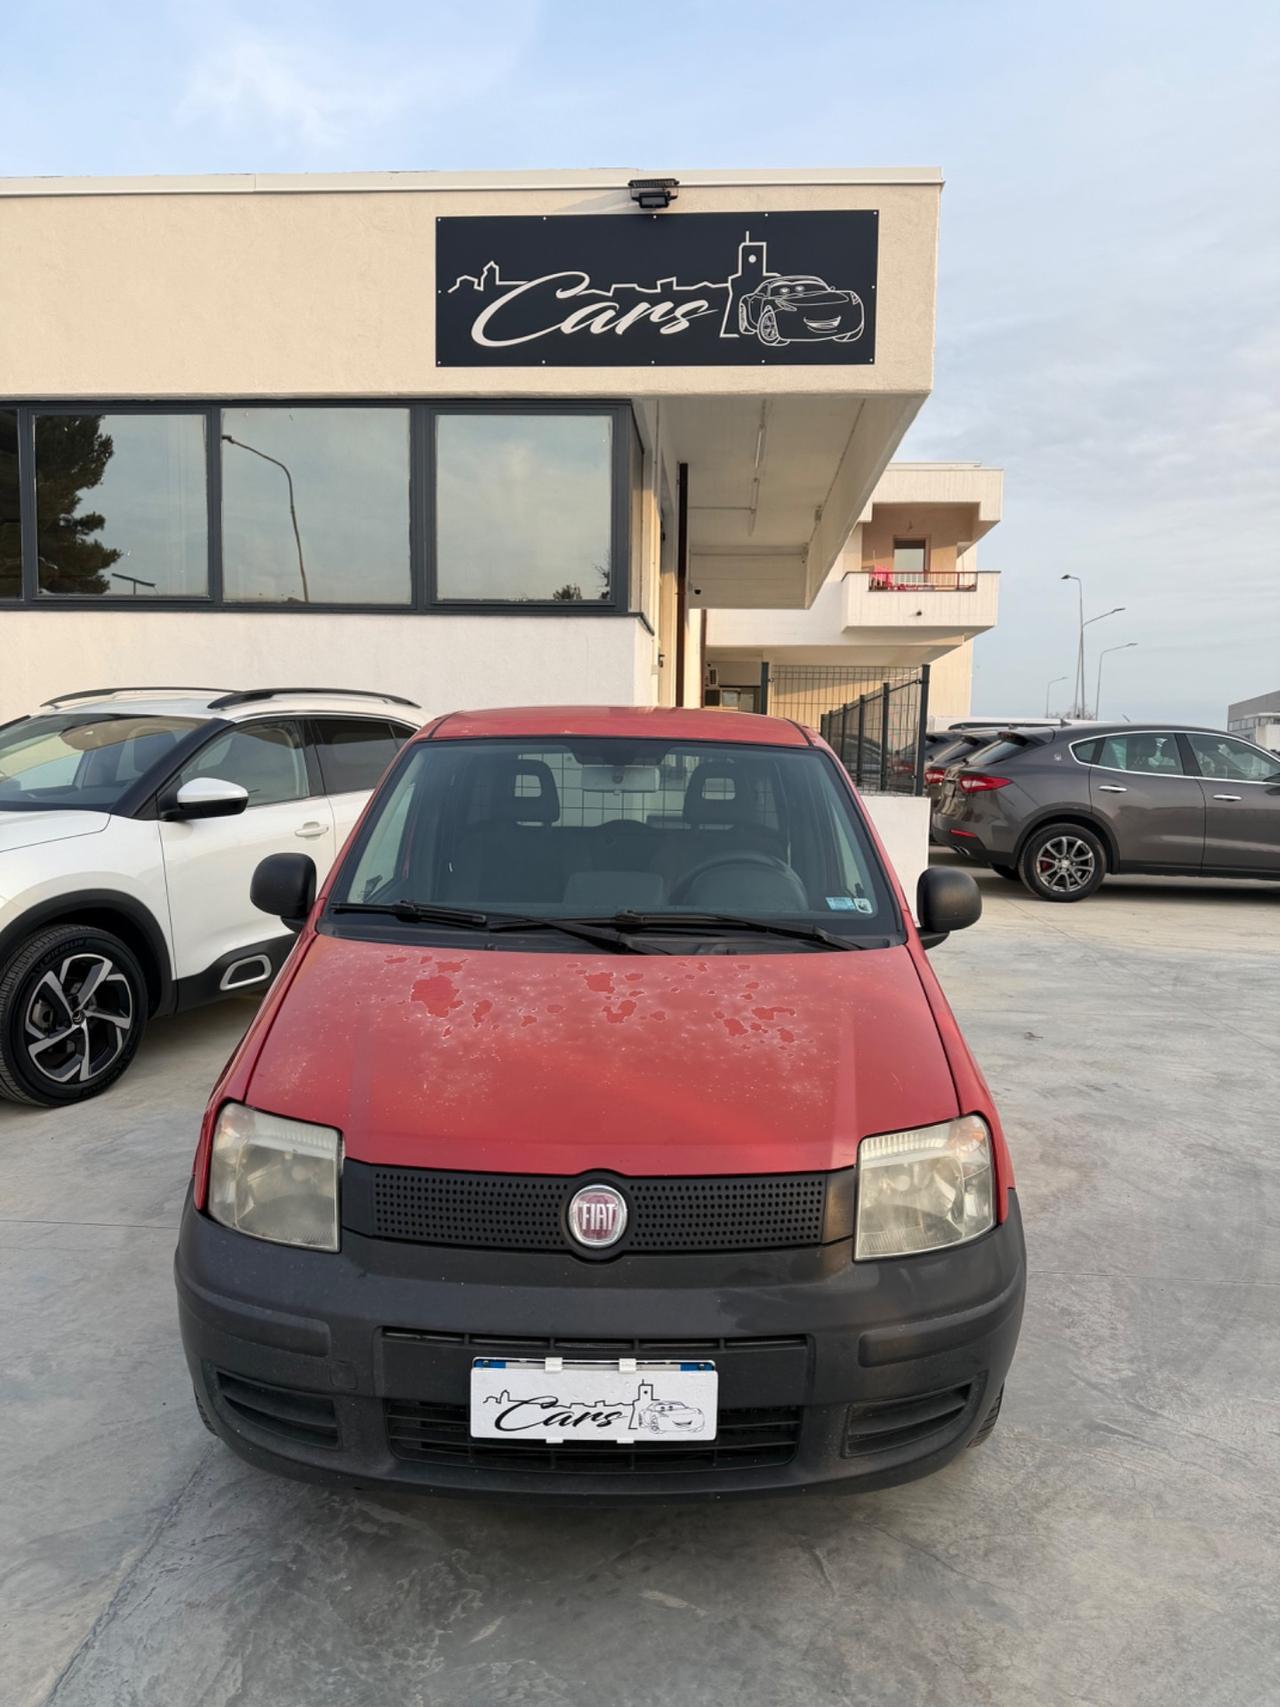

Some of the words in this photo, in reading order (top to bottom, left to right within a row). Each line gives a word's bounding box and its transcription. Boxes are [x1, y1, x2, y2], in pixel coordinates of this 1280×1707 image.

[471, 271, 718, 347] Cars
[582, 1203, 617, 1230] FIAT
[494, 1395, 628, 1431] Cars
